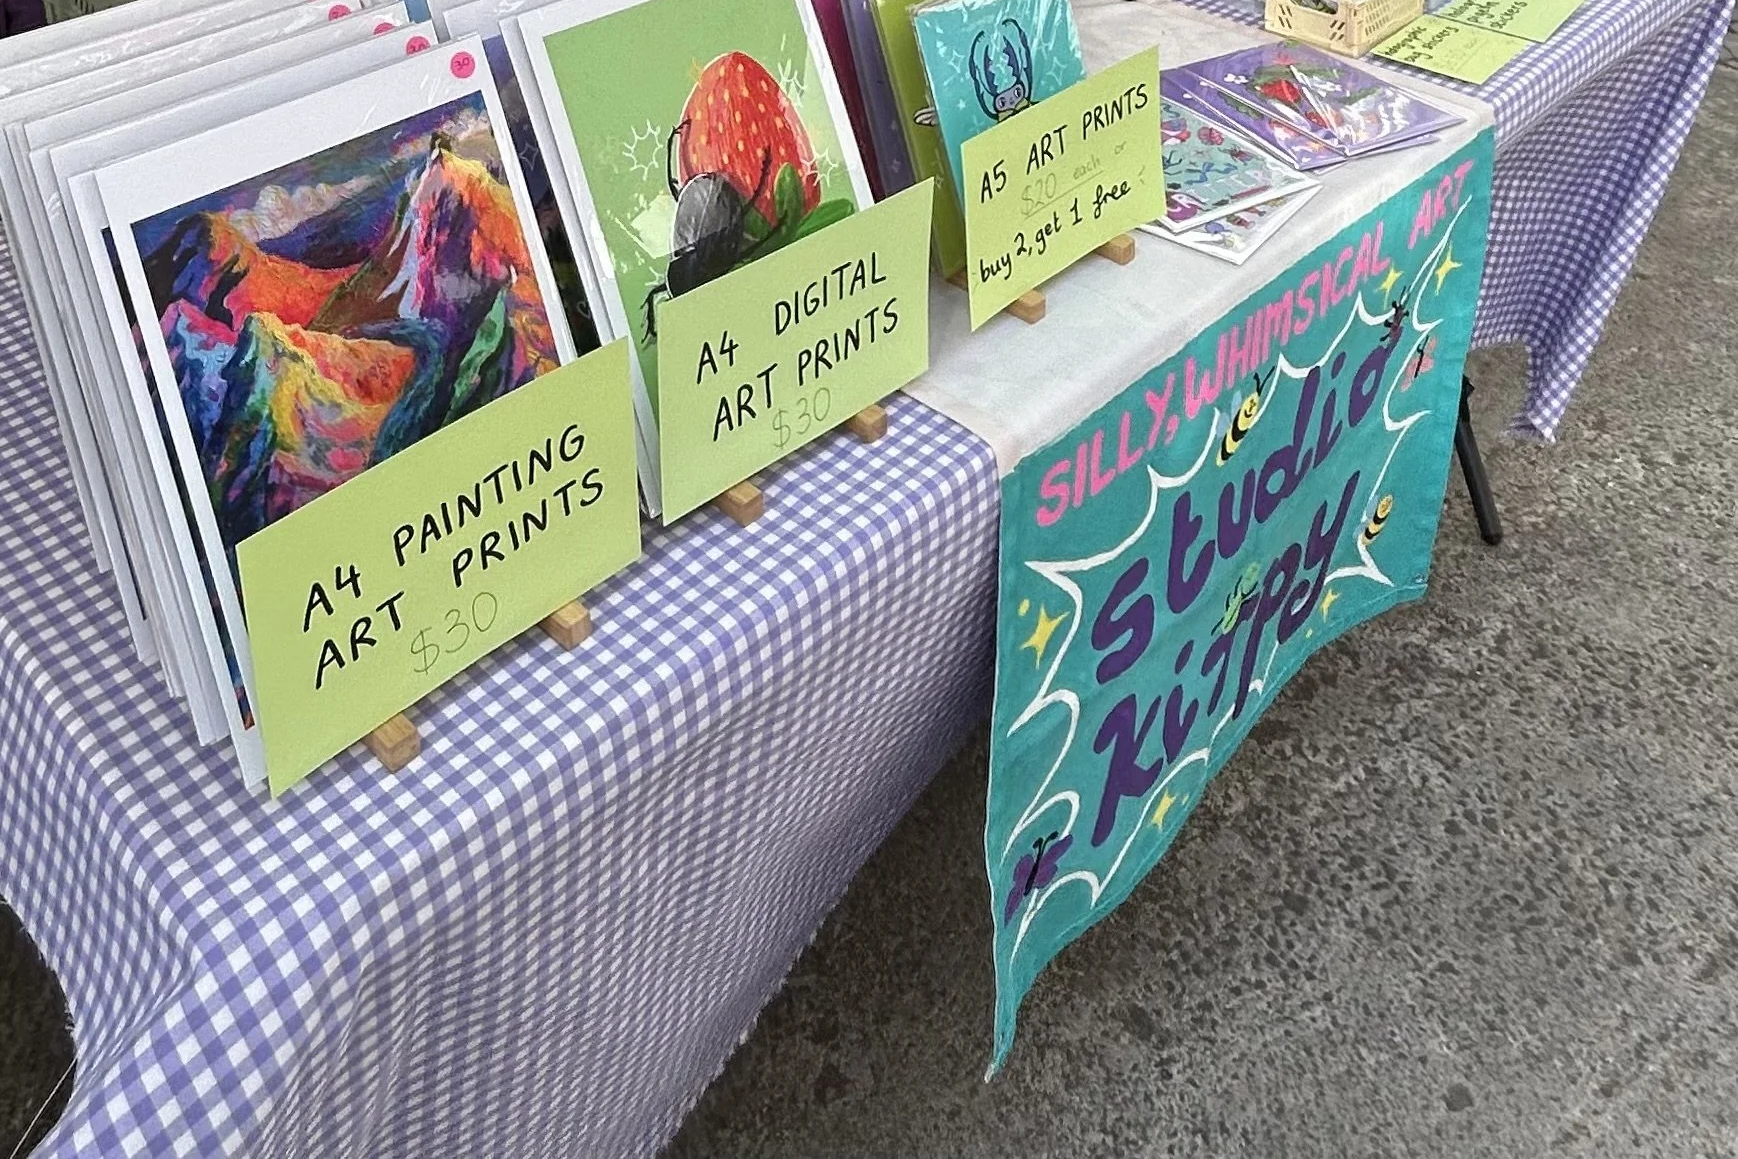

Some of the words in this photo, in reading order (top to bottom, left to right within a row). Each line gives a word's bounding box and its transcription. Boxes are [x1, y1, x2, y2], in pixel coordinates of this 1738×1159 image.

[455, 56, 470, 71] 30
[981, 159, 1008, 204] A5
[1026, 124, 1068, 176] ART
[1083, 83, 1149, 140] PRINTS
[1020, 172, 1057, 216] $20
[1072, 155, 1101, 180] each
[980, 252, 1012, 283] buy
[1035, 212, 1063, 256] get
[1070, 198, 1084, 225] 1
[1093, 179, 1132, 219] free
[1182, 221, 1391, 418] WHIMSICAL
[1407, 160, 1474, 250] ART
[696, 330, 739, 385] A4
[774, 251, 887, 336] DIGITAL
[713, 363, 778, 442] ART
[798, 297, 900, 386] PRINTS
[772, 387, 832, 449] $30
[302, 564, 361, 634] A4
[392, 424, 586, 567] PAINTING
[315, 590, 405, 690] ART
[452, 468, 604, 589] PRINTS
[410, 591, 498, 676] $30
